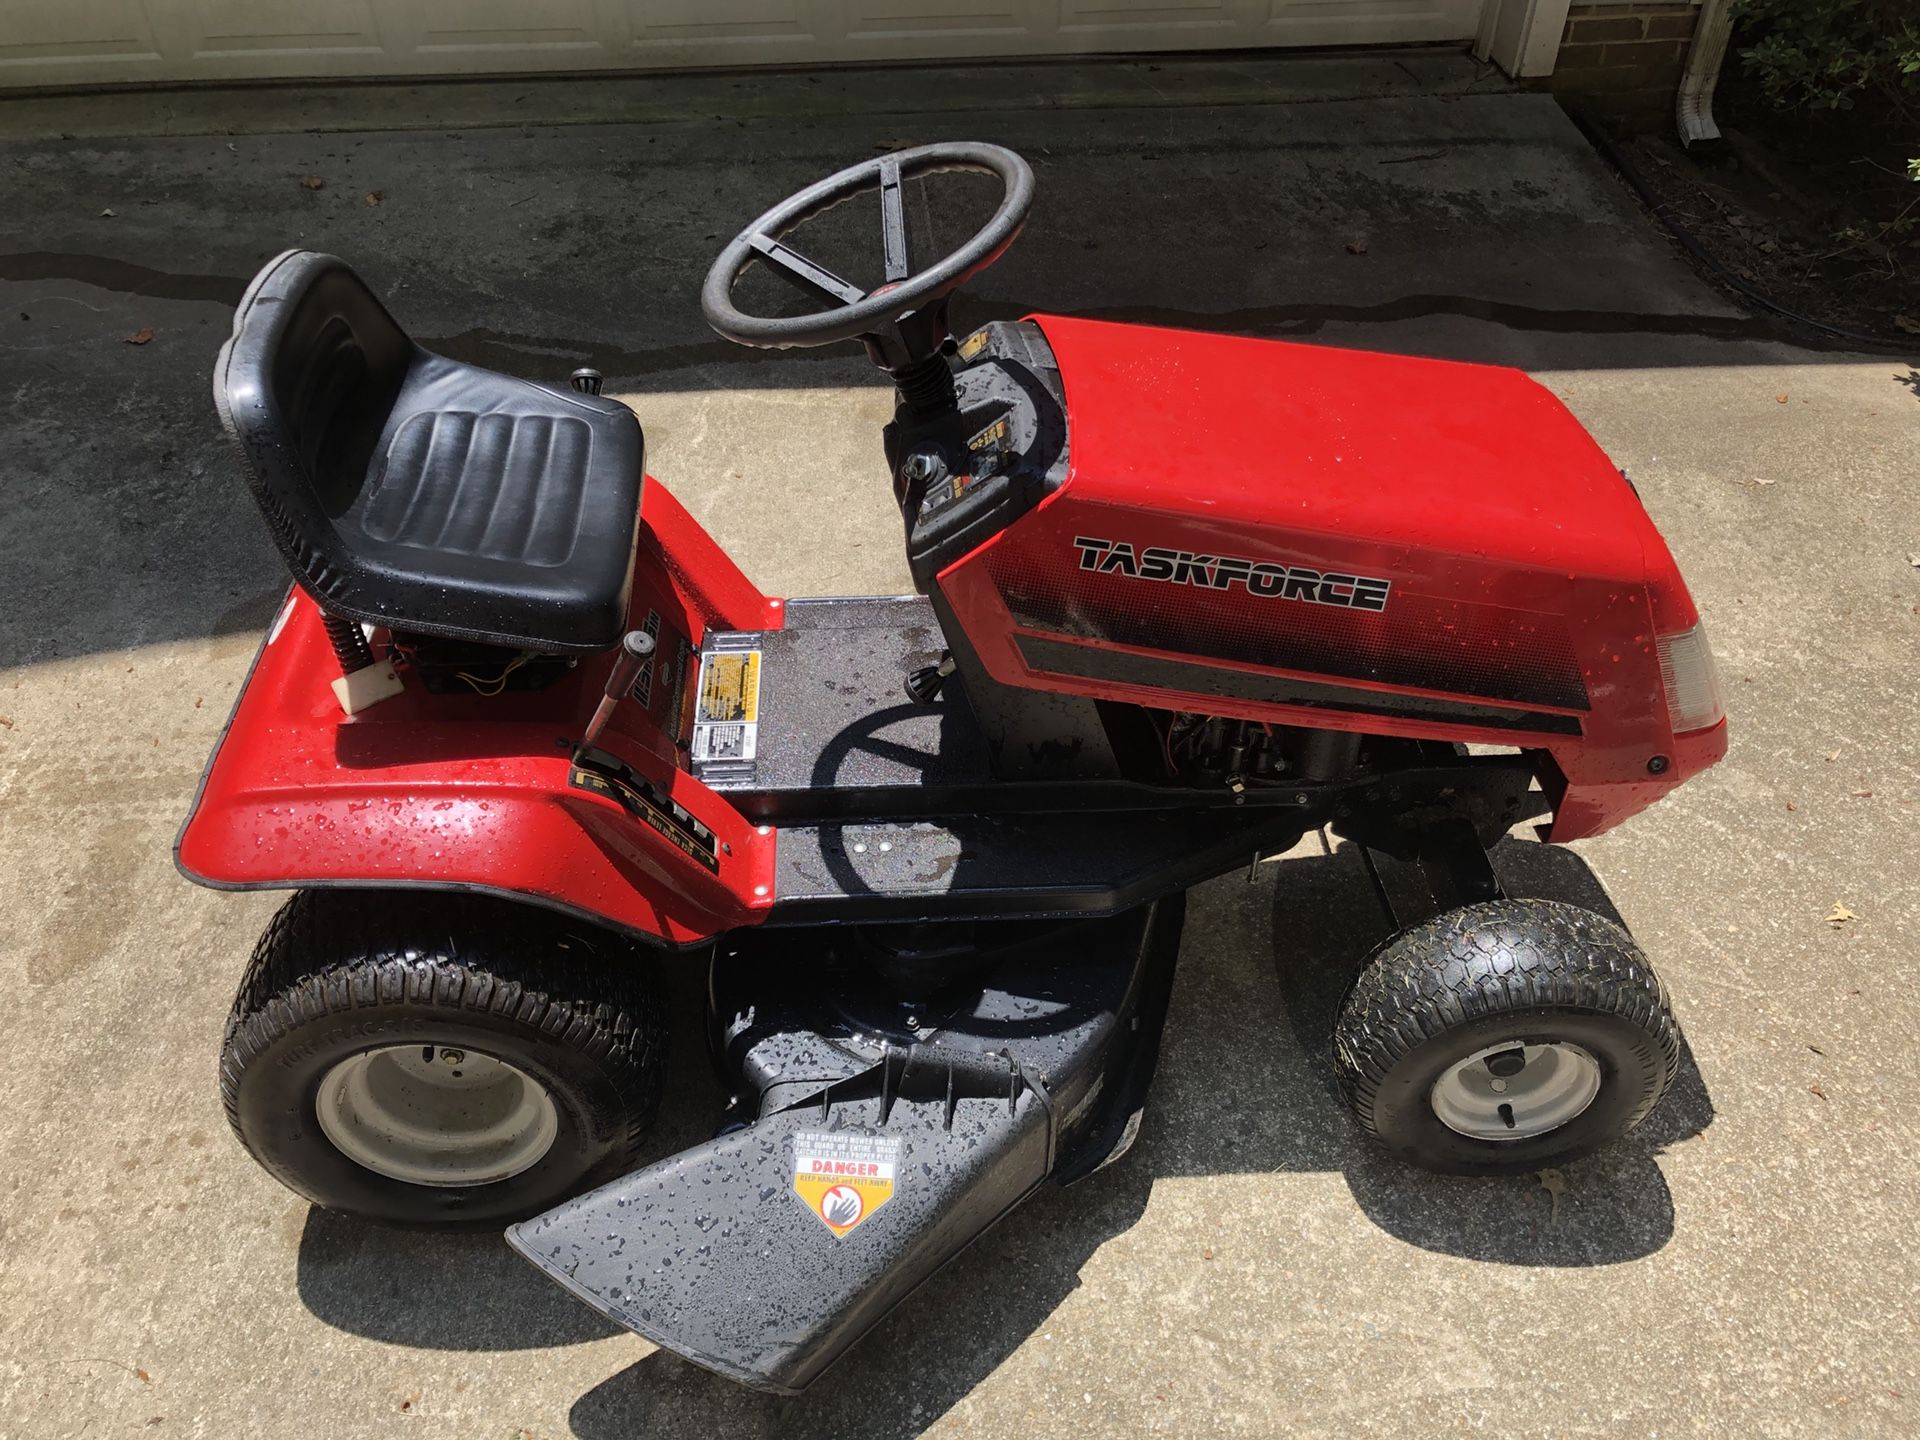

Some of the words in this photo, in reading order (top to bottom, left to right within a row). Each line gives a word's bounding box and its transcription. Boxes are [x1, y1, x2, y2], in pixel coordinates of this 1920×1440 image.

[1073, 536, 1391, 612] TASKFORCE
[747, 669, 757, 713] WARNING
[806, 1132, 819, 1141] NOT
[820, 1134, 849, 1143] OPERATE
[849, 1136, 873, 1145] MOWER
[814, 1142, 834, 1150] GUARD
[812, 1160, 879, 1176] DANGER
[818, 1176, 839, 1184] HANDS
[854, 1178, 868, 1186] FEET
[869, 1179, 888, 1187] AWAY
